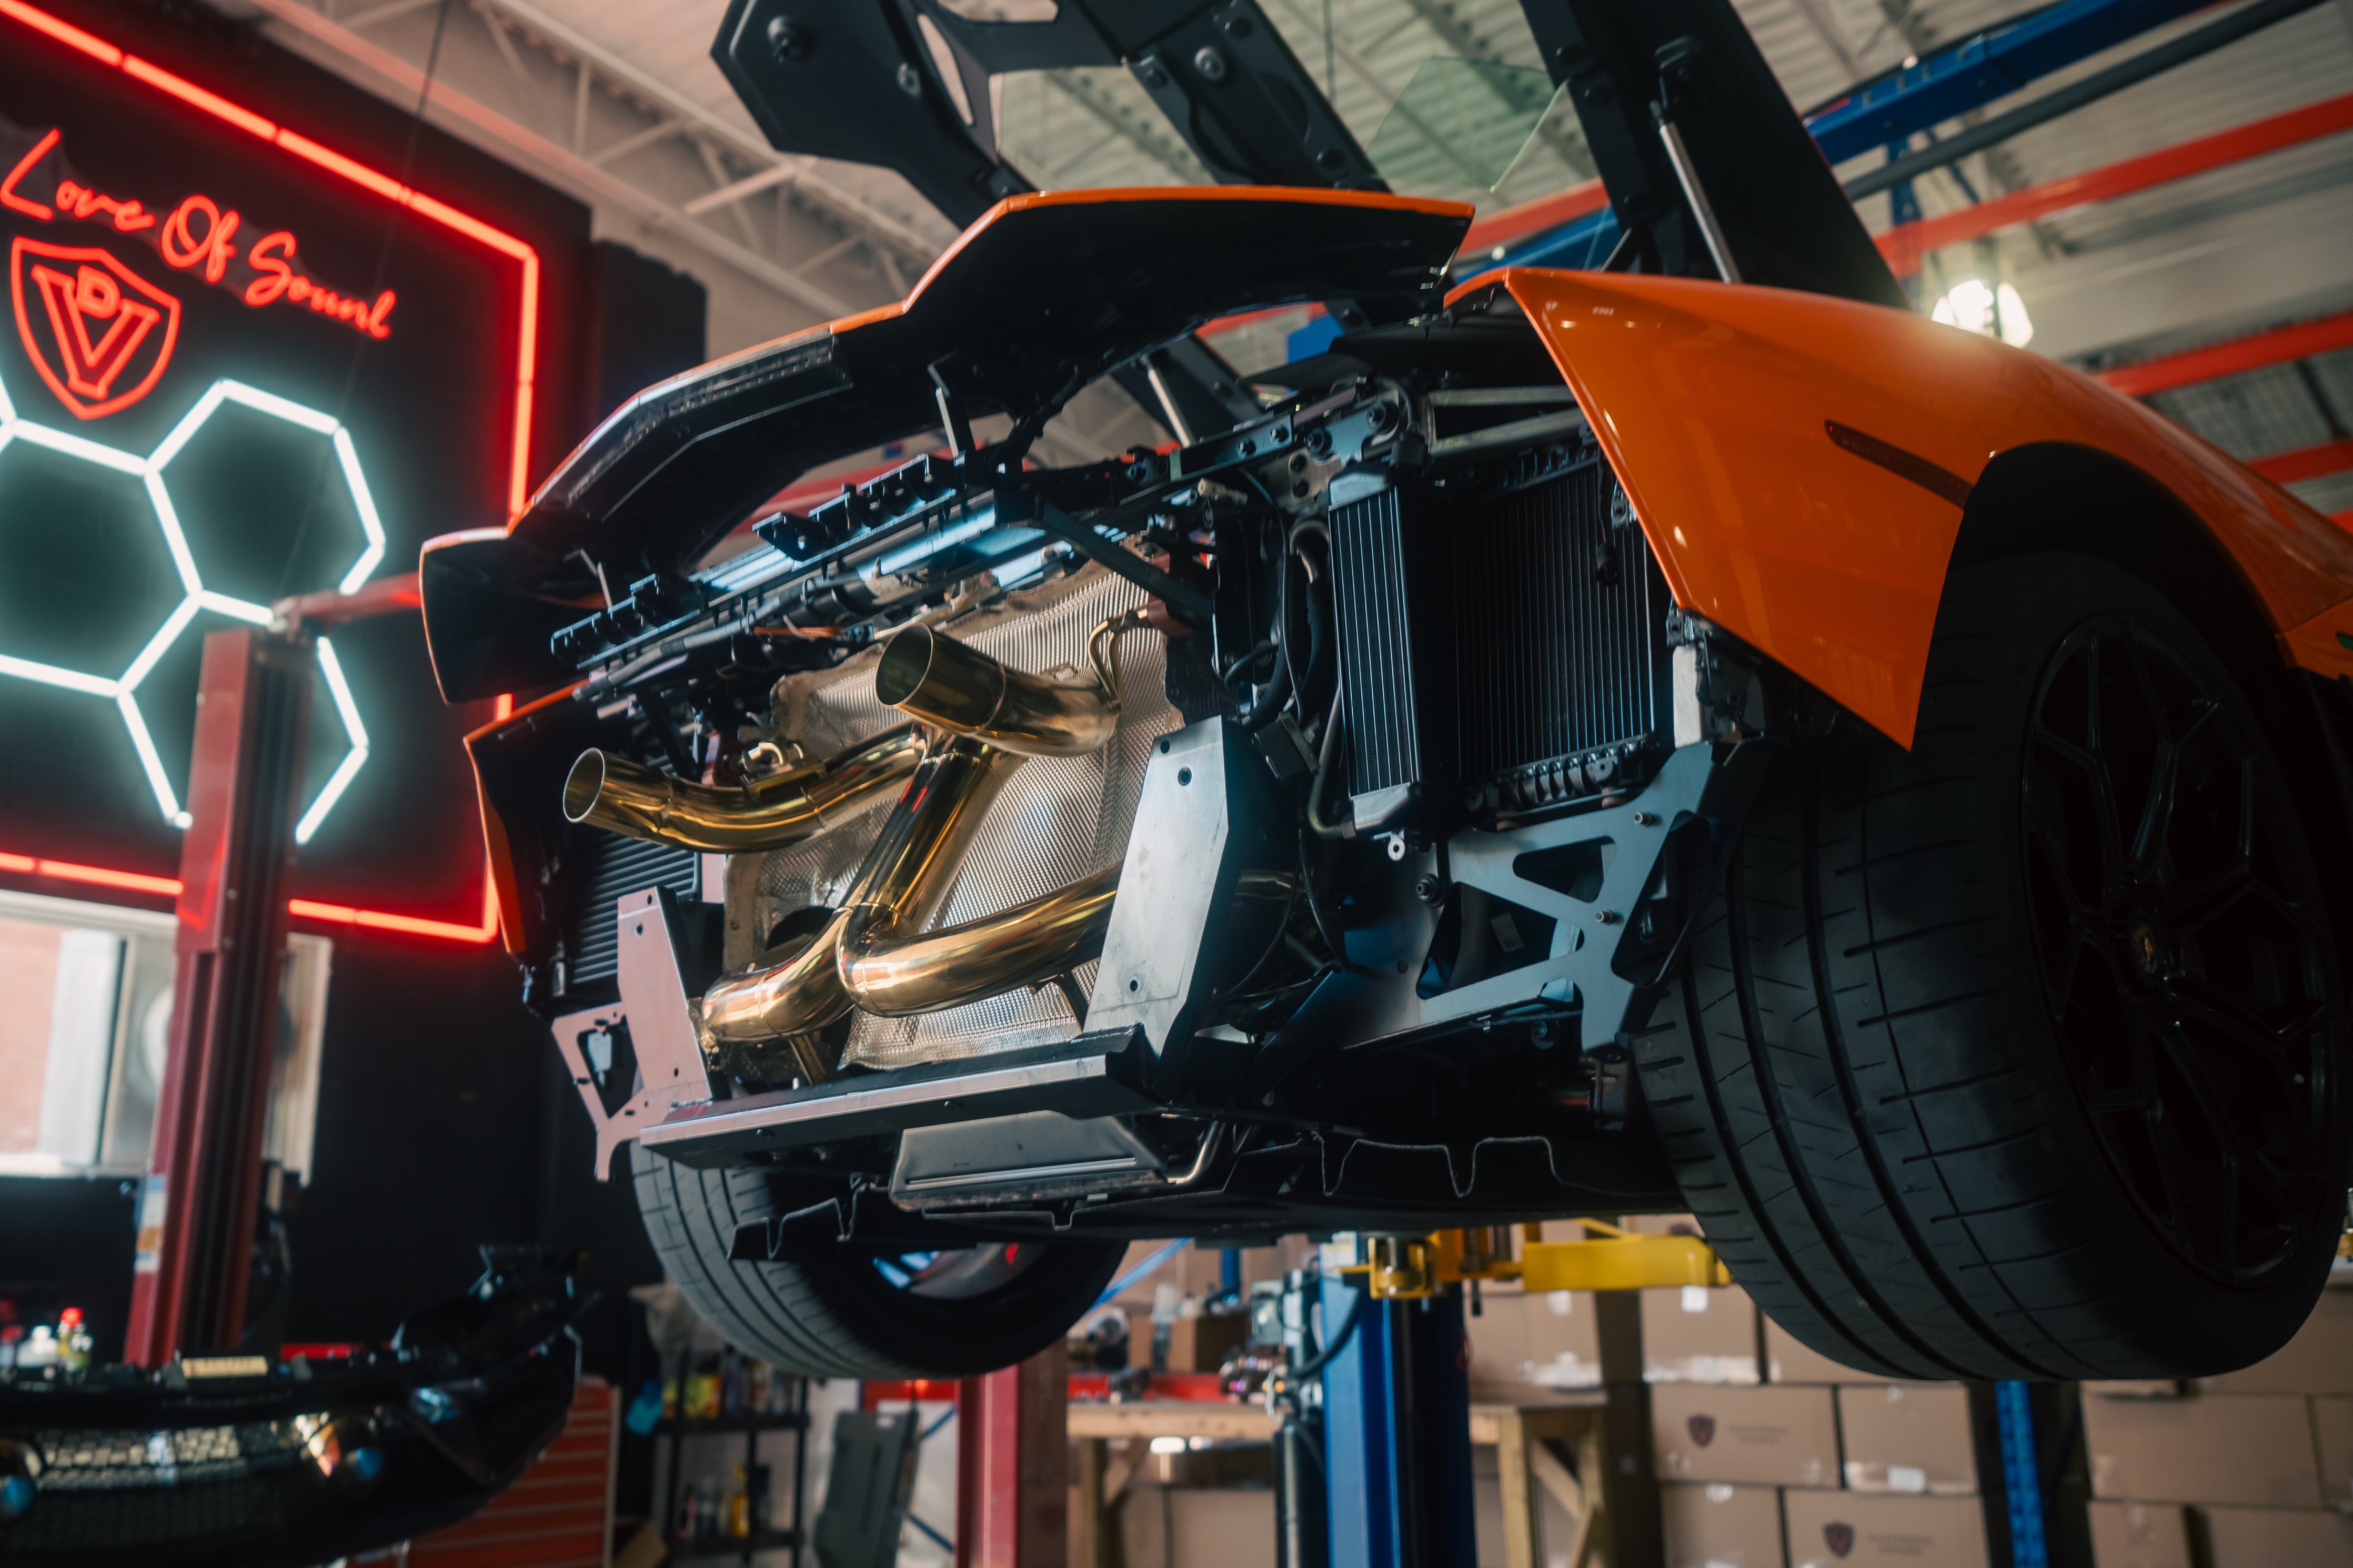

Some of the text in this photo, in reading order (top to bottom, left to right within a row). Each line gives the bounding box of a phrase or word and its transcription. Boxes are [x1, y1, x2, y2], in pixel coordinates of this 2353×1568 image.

[0, 127, 397, 340] Love Of Sound
